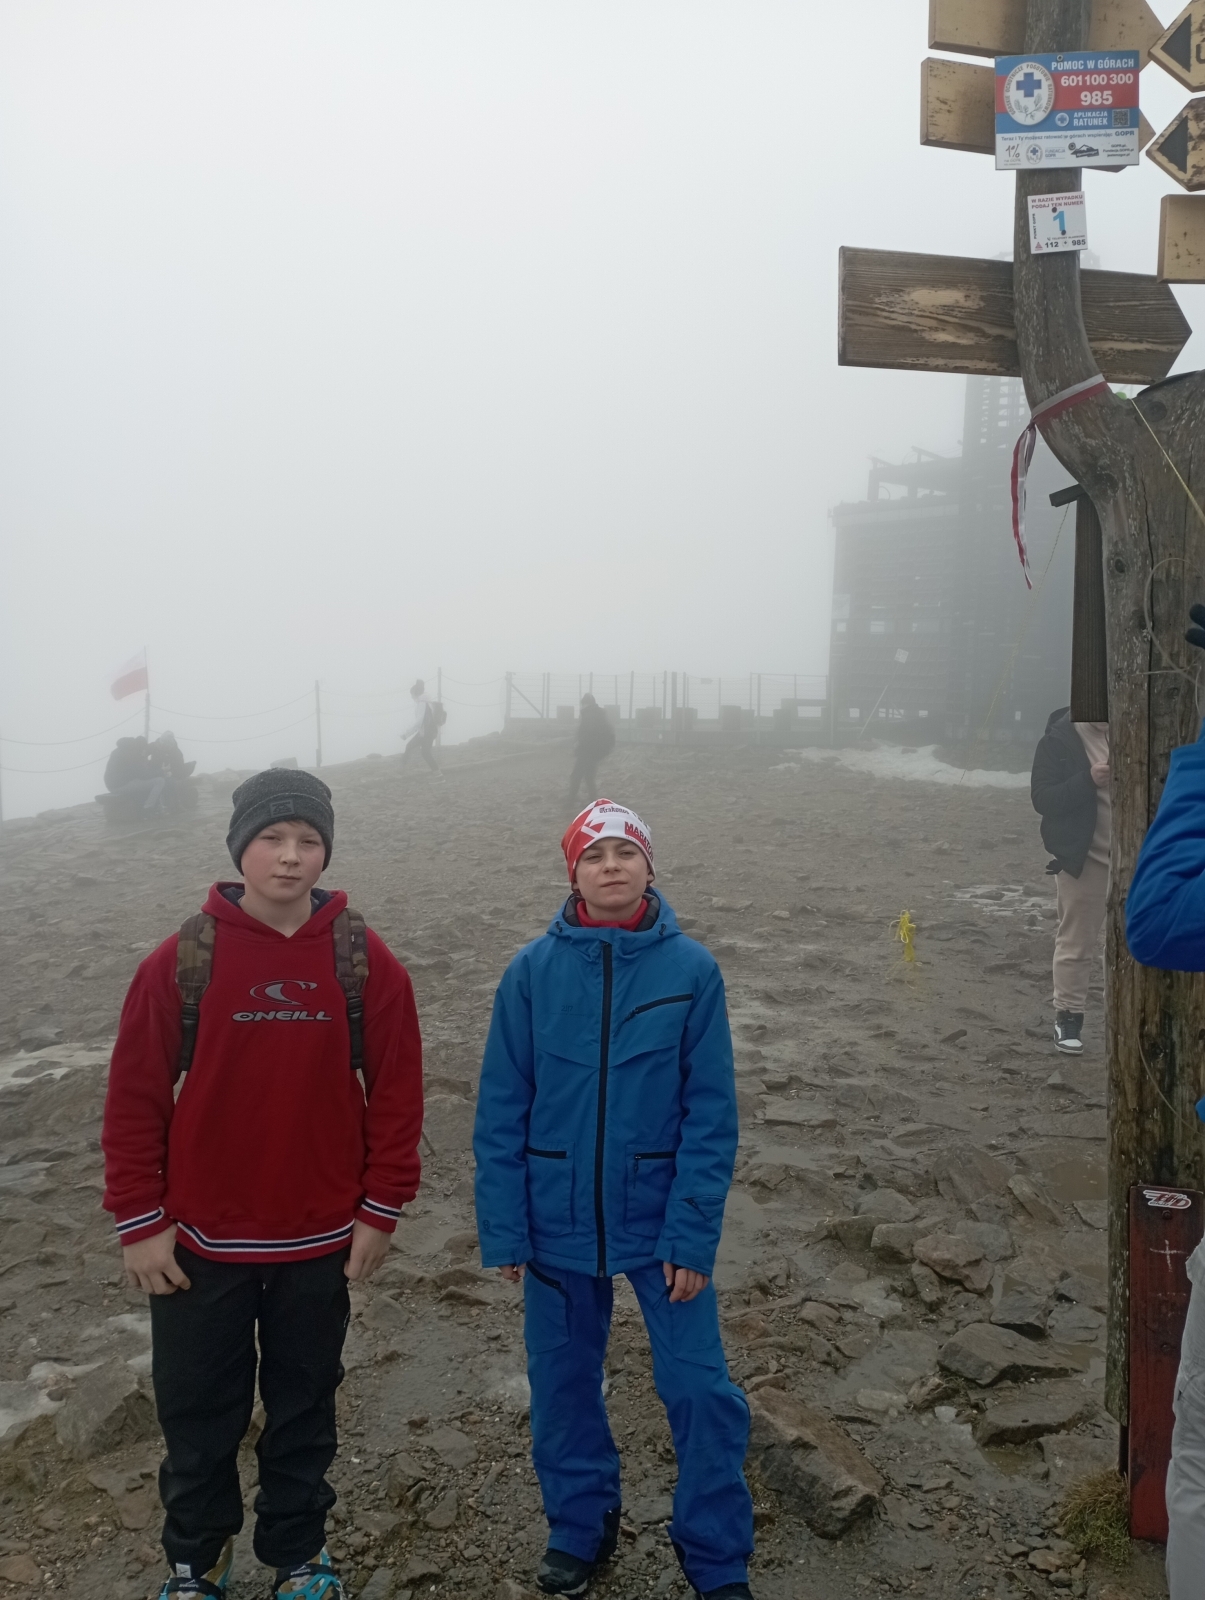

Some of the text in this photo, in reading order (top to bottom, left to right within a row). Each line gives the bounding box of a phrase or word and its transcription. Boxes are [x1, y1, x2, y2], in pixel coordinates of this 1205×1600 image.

[1051, 57, 1134, 71] POMOC W GÓRACH
[1026, 63, 1051, 83] POGOTOWIE
[1060, 73, 1134, 87] 601 100 300
[1080, 90, 1113, 105] 985
[1073, 118, 1108, 126] RATUNEK
[1005, 143, 1021, 158] 1%
[1052, 210, 1066, 233] 1
